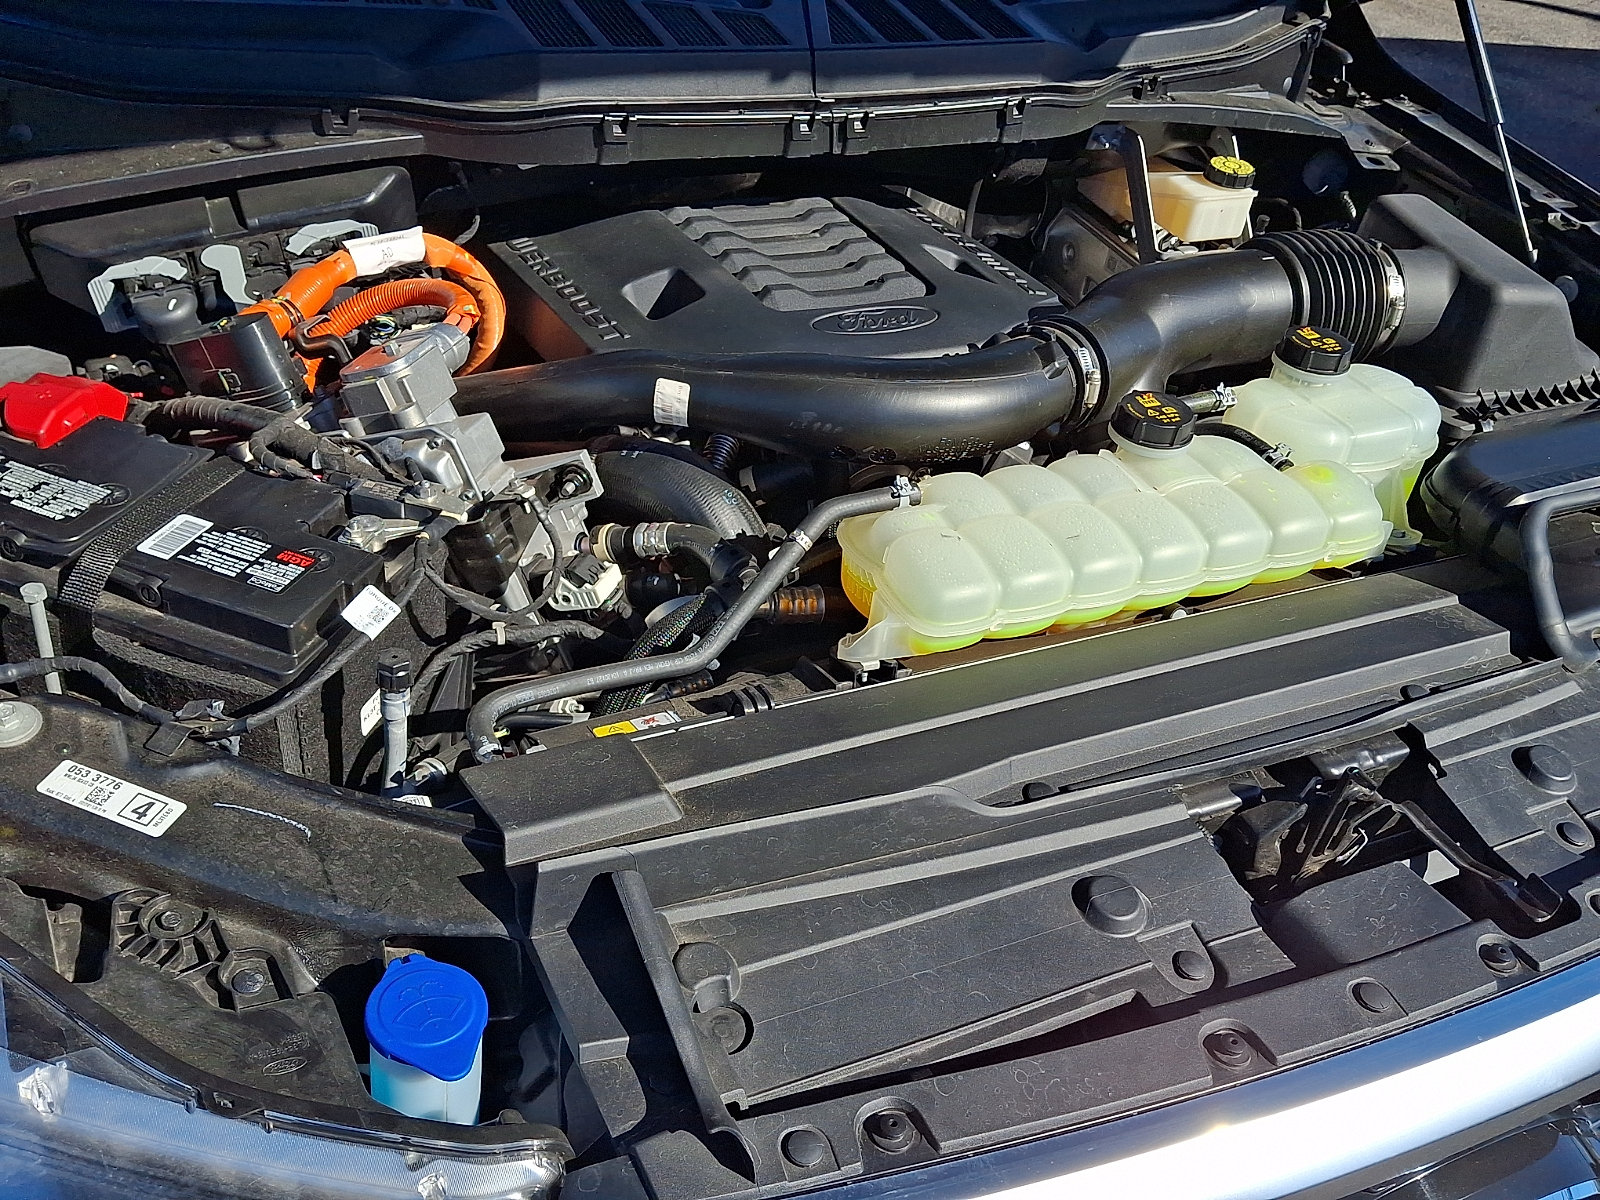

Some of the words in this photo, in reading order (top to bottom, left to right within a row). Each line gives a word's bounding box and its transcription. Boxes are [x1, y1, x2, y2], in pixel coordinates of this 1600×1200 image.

[837, 309, 920, 332] Ford
[276, 552, 313, 567] AGM
[67, 764, 92, 779] 053
[91, 772, 124, 791] 3776
[131, 801, 157, 821] 4
